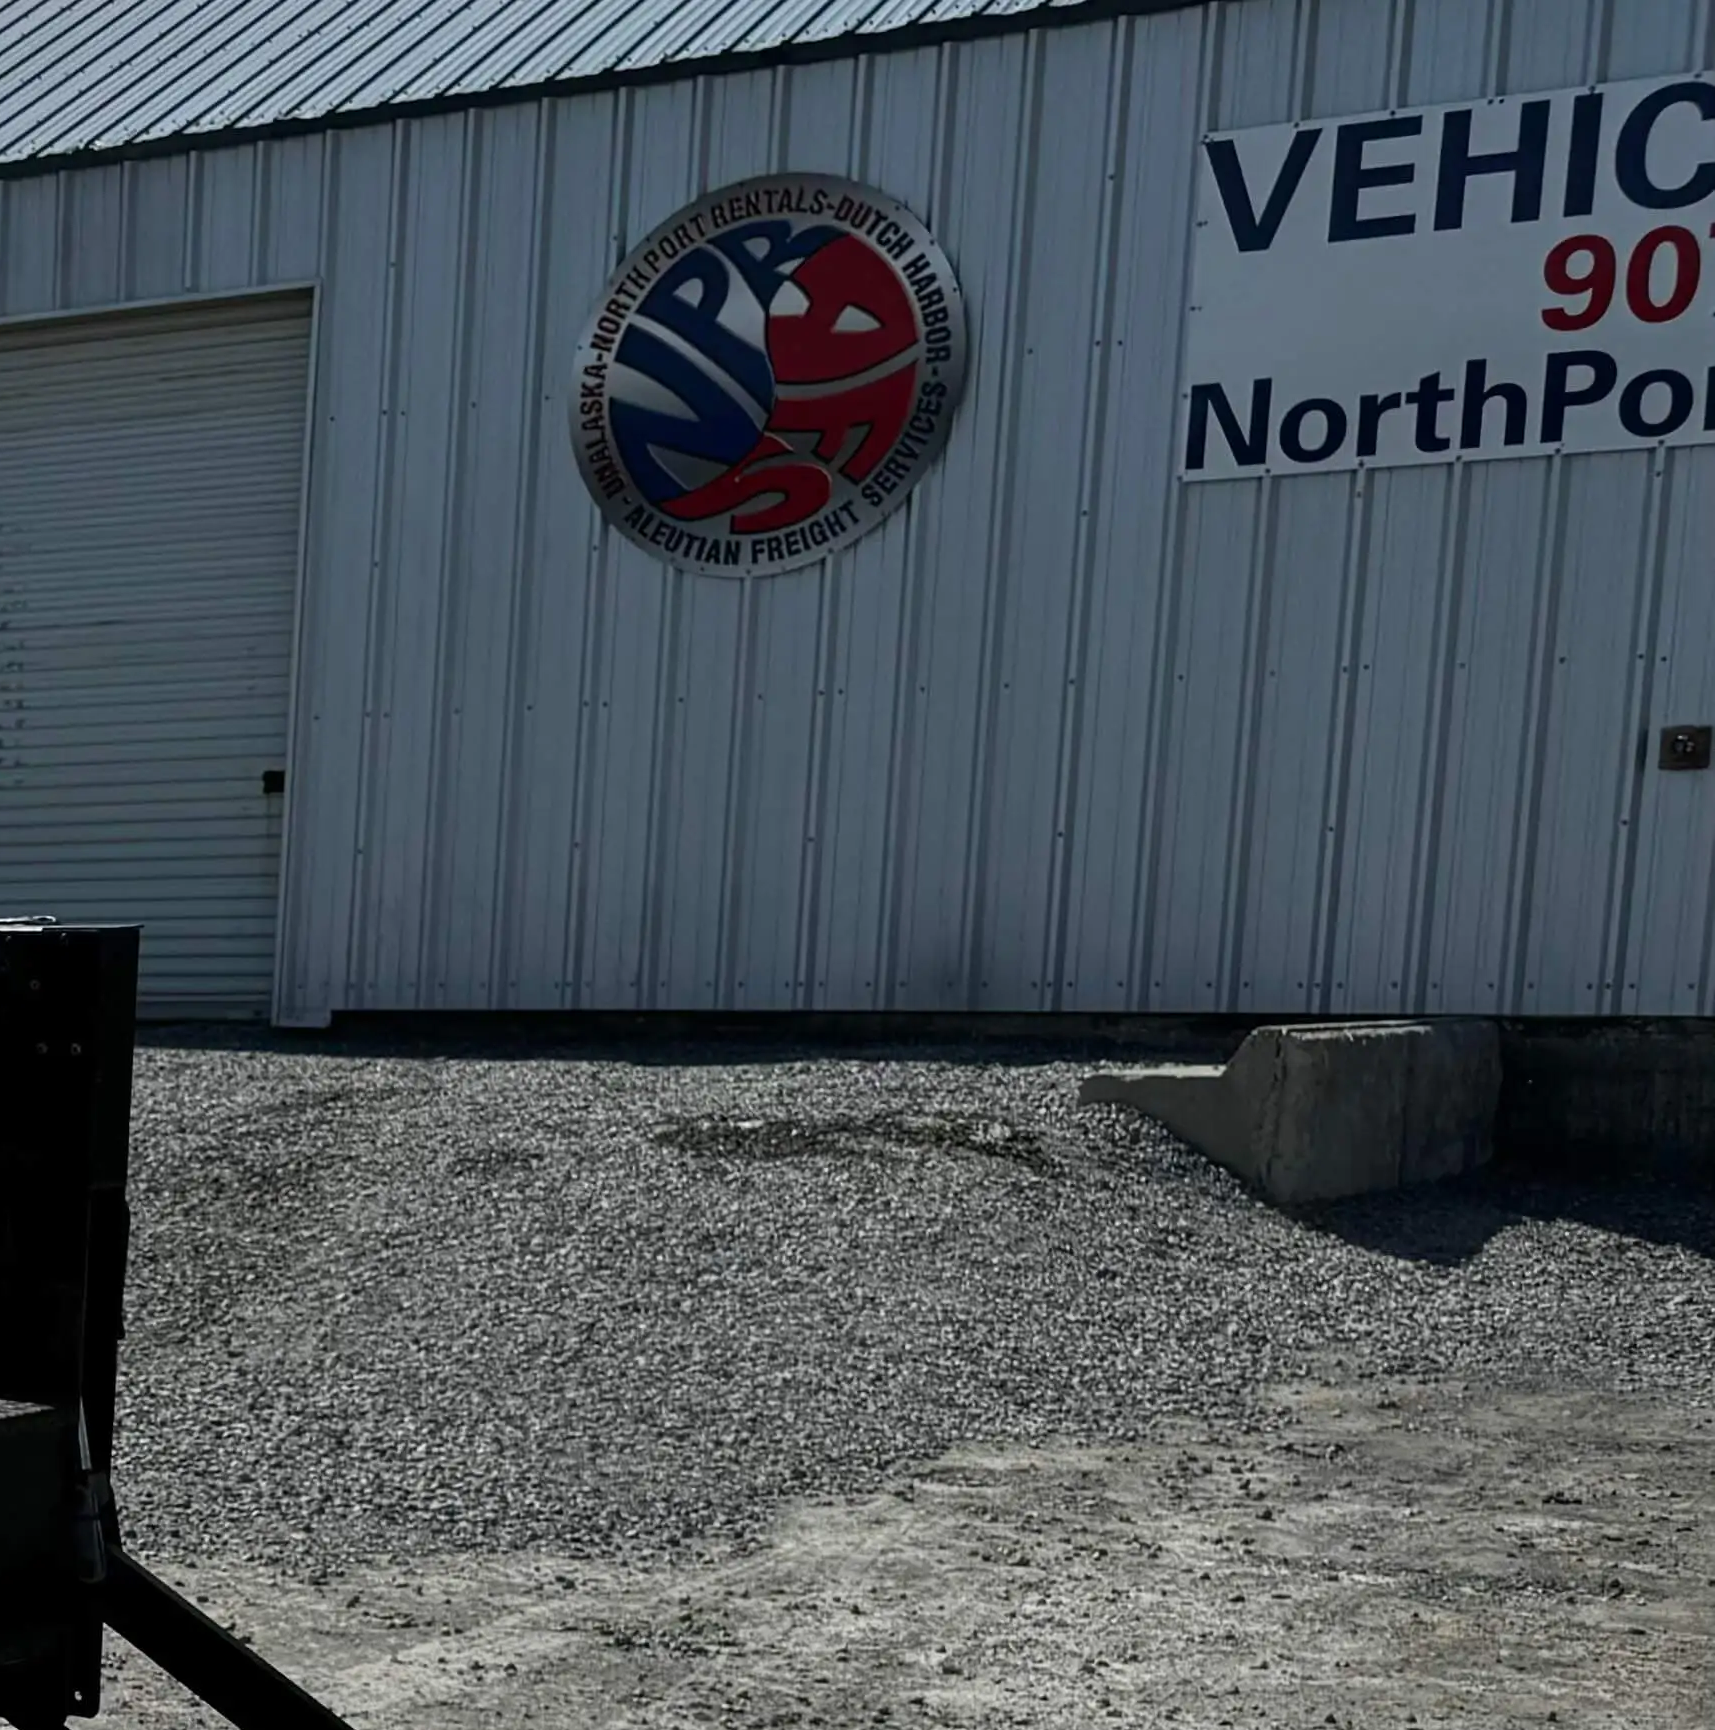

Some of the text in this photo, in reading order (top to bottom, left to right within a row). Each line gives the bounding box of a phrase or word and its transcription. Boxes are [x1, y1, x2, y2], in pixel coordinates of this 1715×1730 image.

[1206, 81, 1715, 252] VEHIC
[643, 213, 707, 274] PORT
[901, 252, 951, 365] HARBOR
[1541, 224, 1715, 332] 90
[624, 382, 948, 565] ALEUTIAN FREIGHT SERVICES
[1185, 349, 1715, 471] NorthPo
